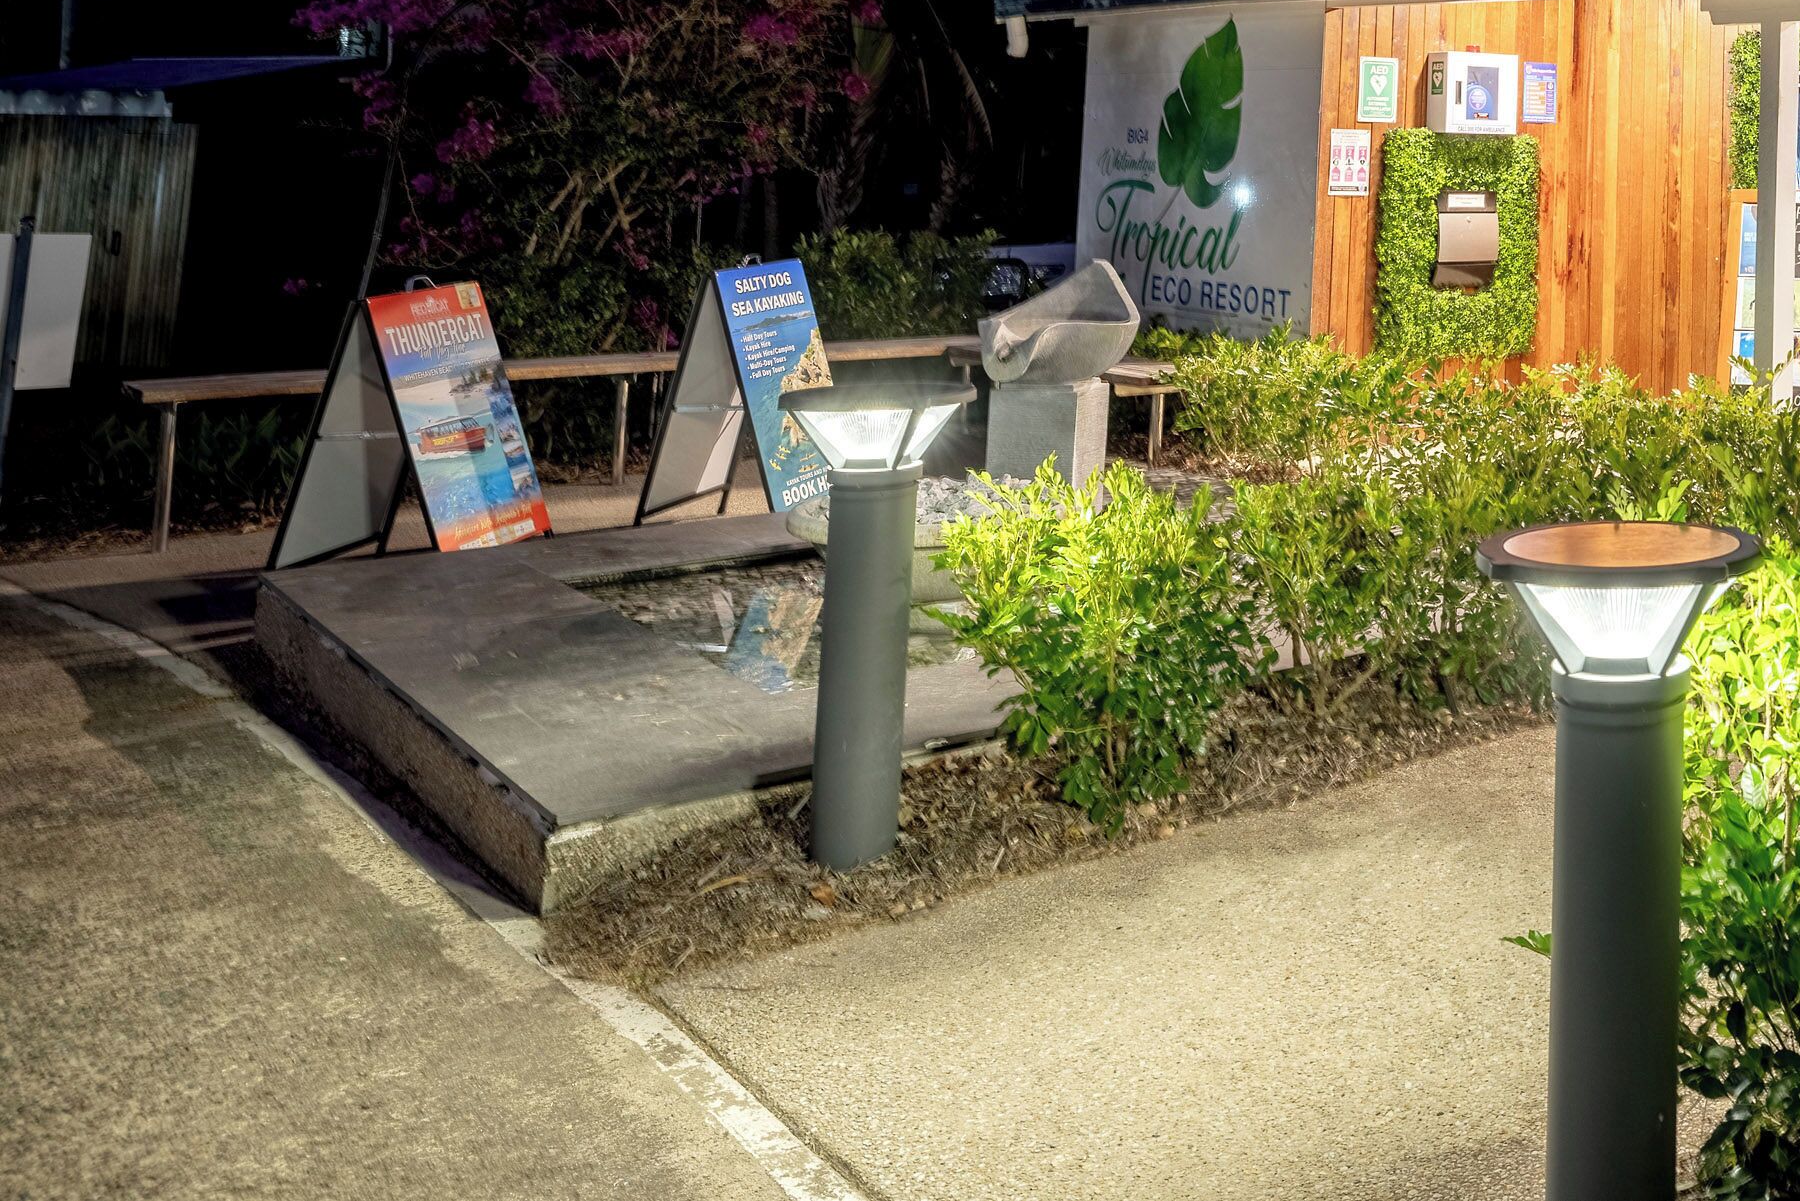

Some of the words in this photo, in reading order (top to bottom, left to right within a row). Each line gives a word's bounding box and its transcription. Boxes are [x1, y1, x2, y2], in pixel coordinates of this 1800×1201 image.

[1370, 66, 1388, 74] AED
[1128, 128, 1149, 144] BIG4
[1096, 179, 1244, 307] Tropical
[735, 276, 767, 294] SALTY
[768, 272, 792, 288] DOG
[732, 301, 754, 316] SEA
[754, 291, 805, 312] KAYAKING
[1152, 276, 1192, 305] ECO
[1201, 282, 1291, 318] RESORT
[384, 313, 485, 356] THUNDERCAT
[754, 333, 763, 341] Day
[764, 330, 777, 338] Tours
[745, 343, 760, 352] Kayak
[747, 352, 763, 360] Kayak
[763, 344, 795, 357] Hire/Camping
[750, 358, 772, 370] Multi-Day
[773, 356, 786, 365] Tours
[404, 367, 439, 381] WHITEHAVEN
[752, 371, 762, 379] Full
[763, 368, 772, 376] Day
[772, 365, 785, 374] Tours
[786, 477, 800, 486] KAYAK
[800, 472, 814, 481] TOURS
[782, 480, 818, 507] BOOK
